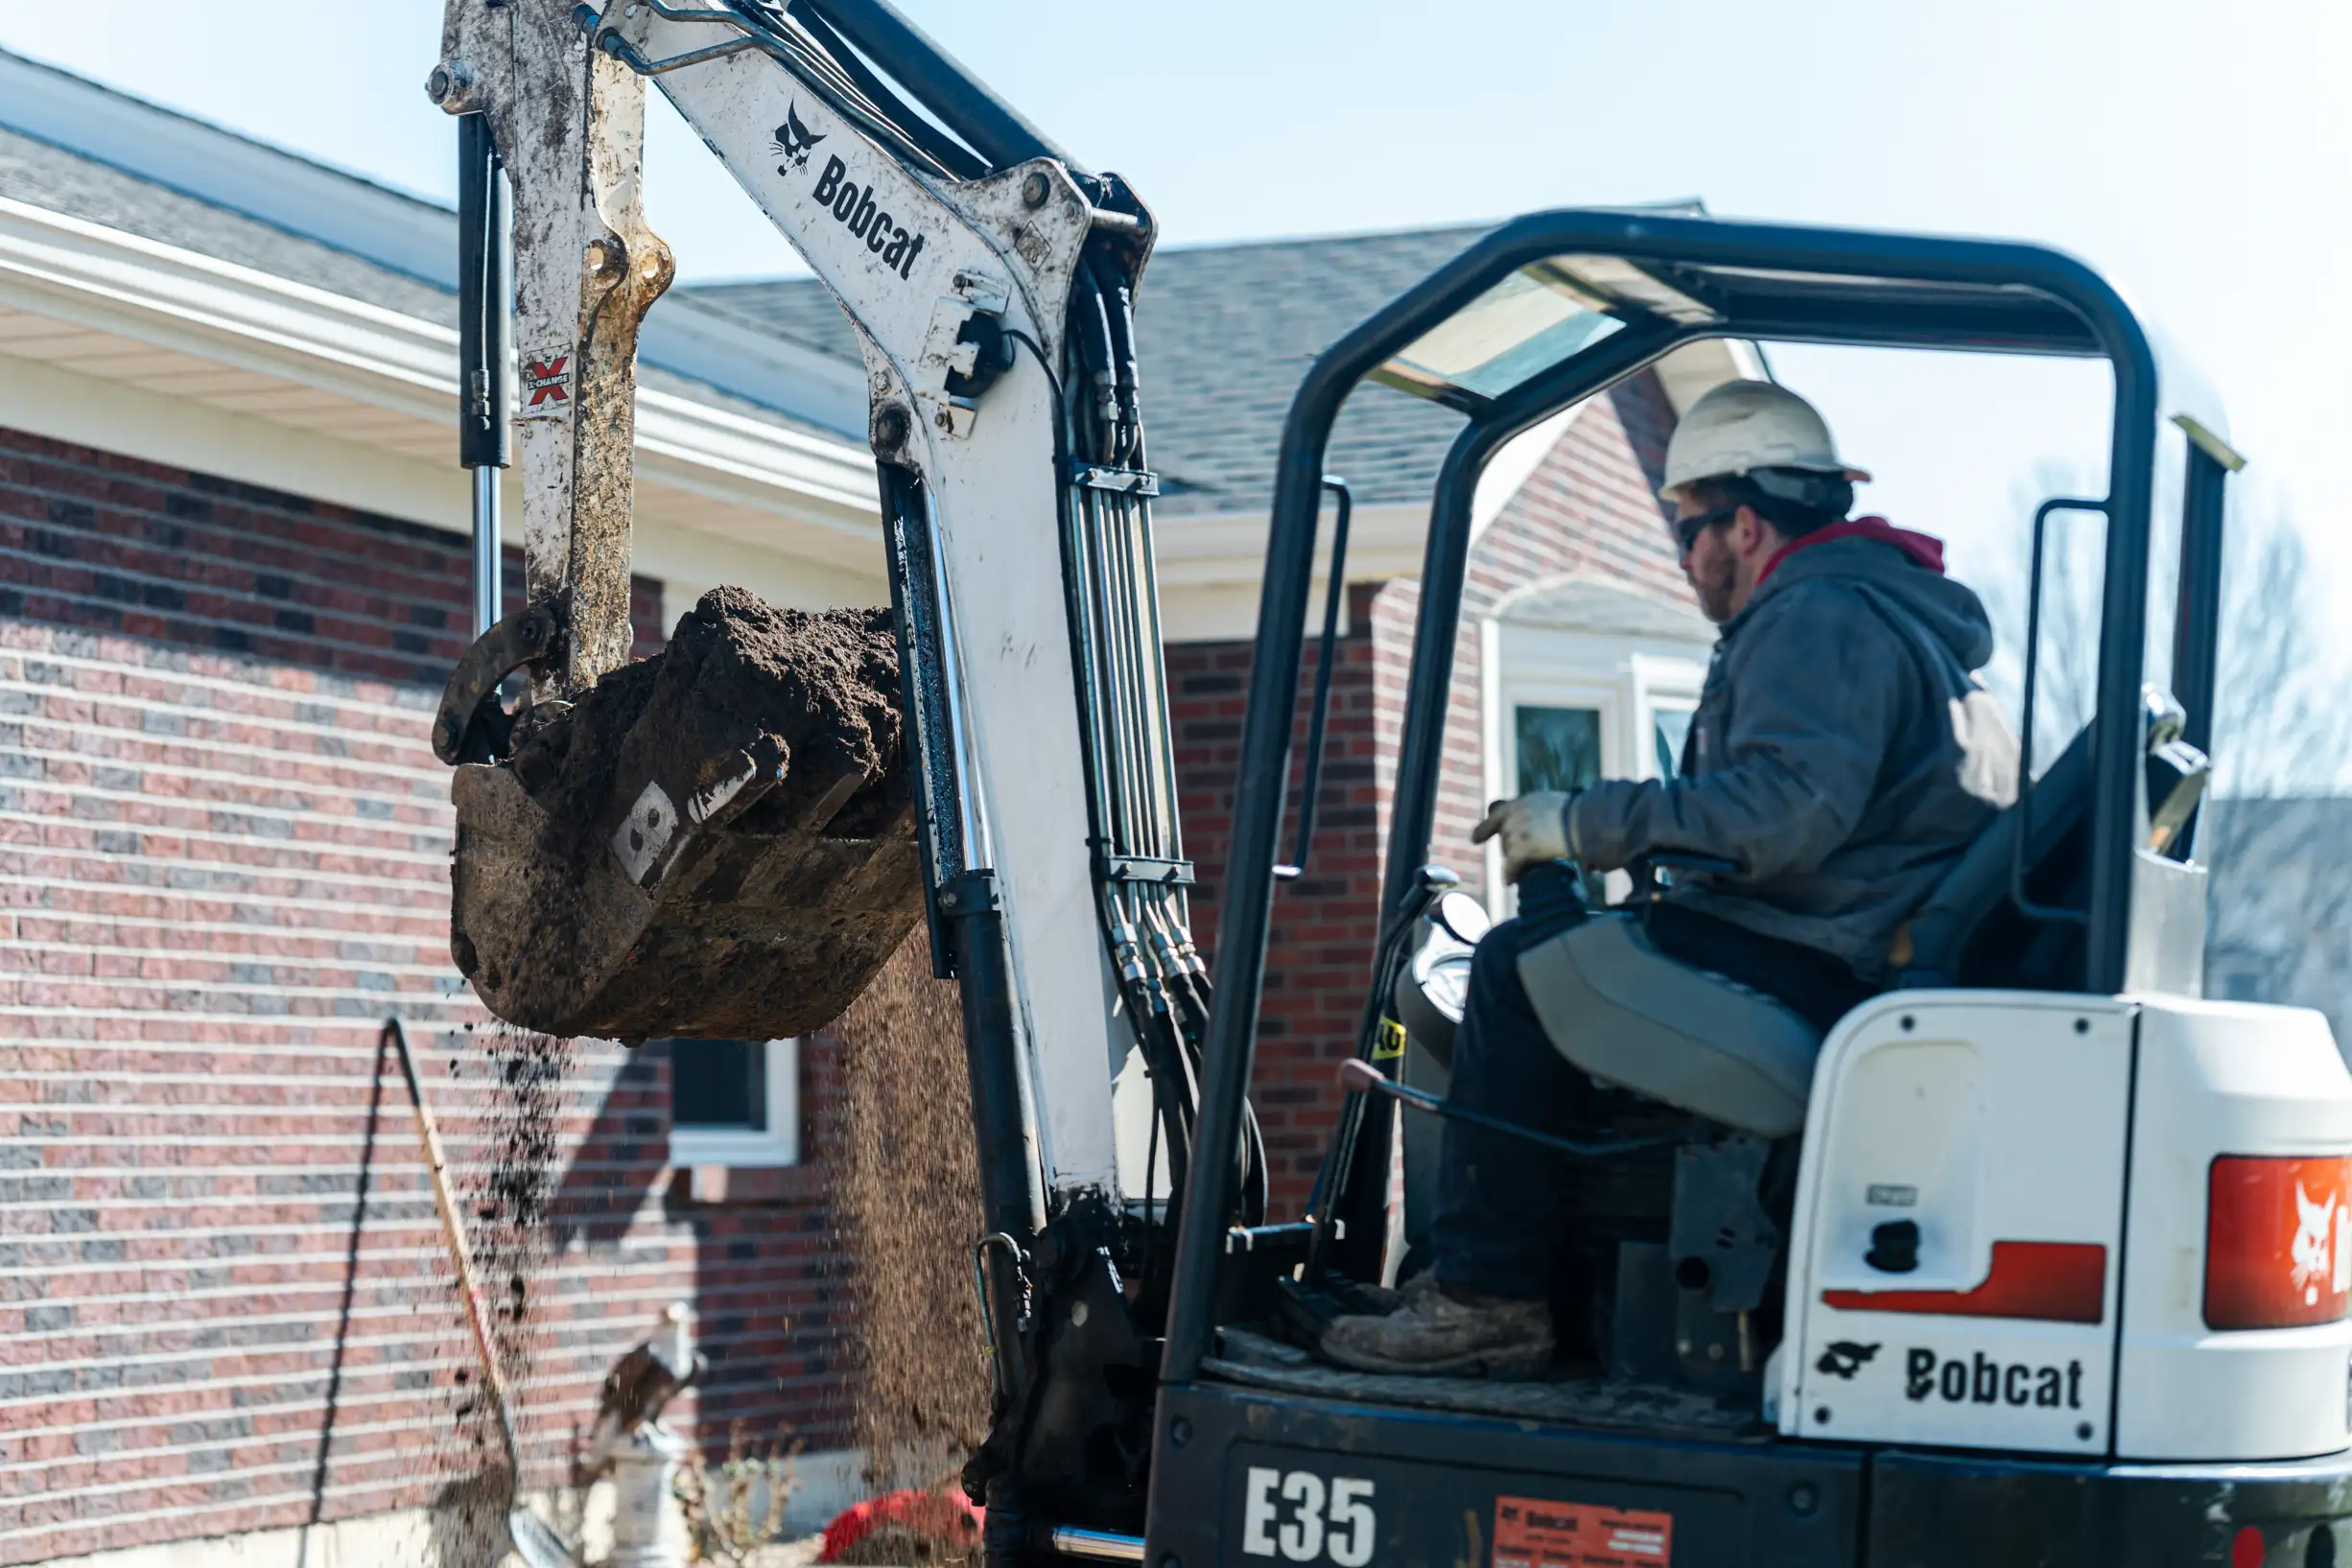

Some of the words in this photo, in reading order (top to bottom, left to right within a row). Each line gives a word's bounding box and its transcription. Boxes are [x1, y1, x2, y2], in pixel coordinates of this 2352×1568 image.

[812, 153, 925, 281] Bobcat
[528, 375, 568, 389] X-CHANGE
[1905, 1347, 2082, 1410] Bobcat
[1243, 1466, 1376, 1568] E35
